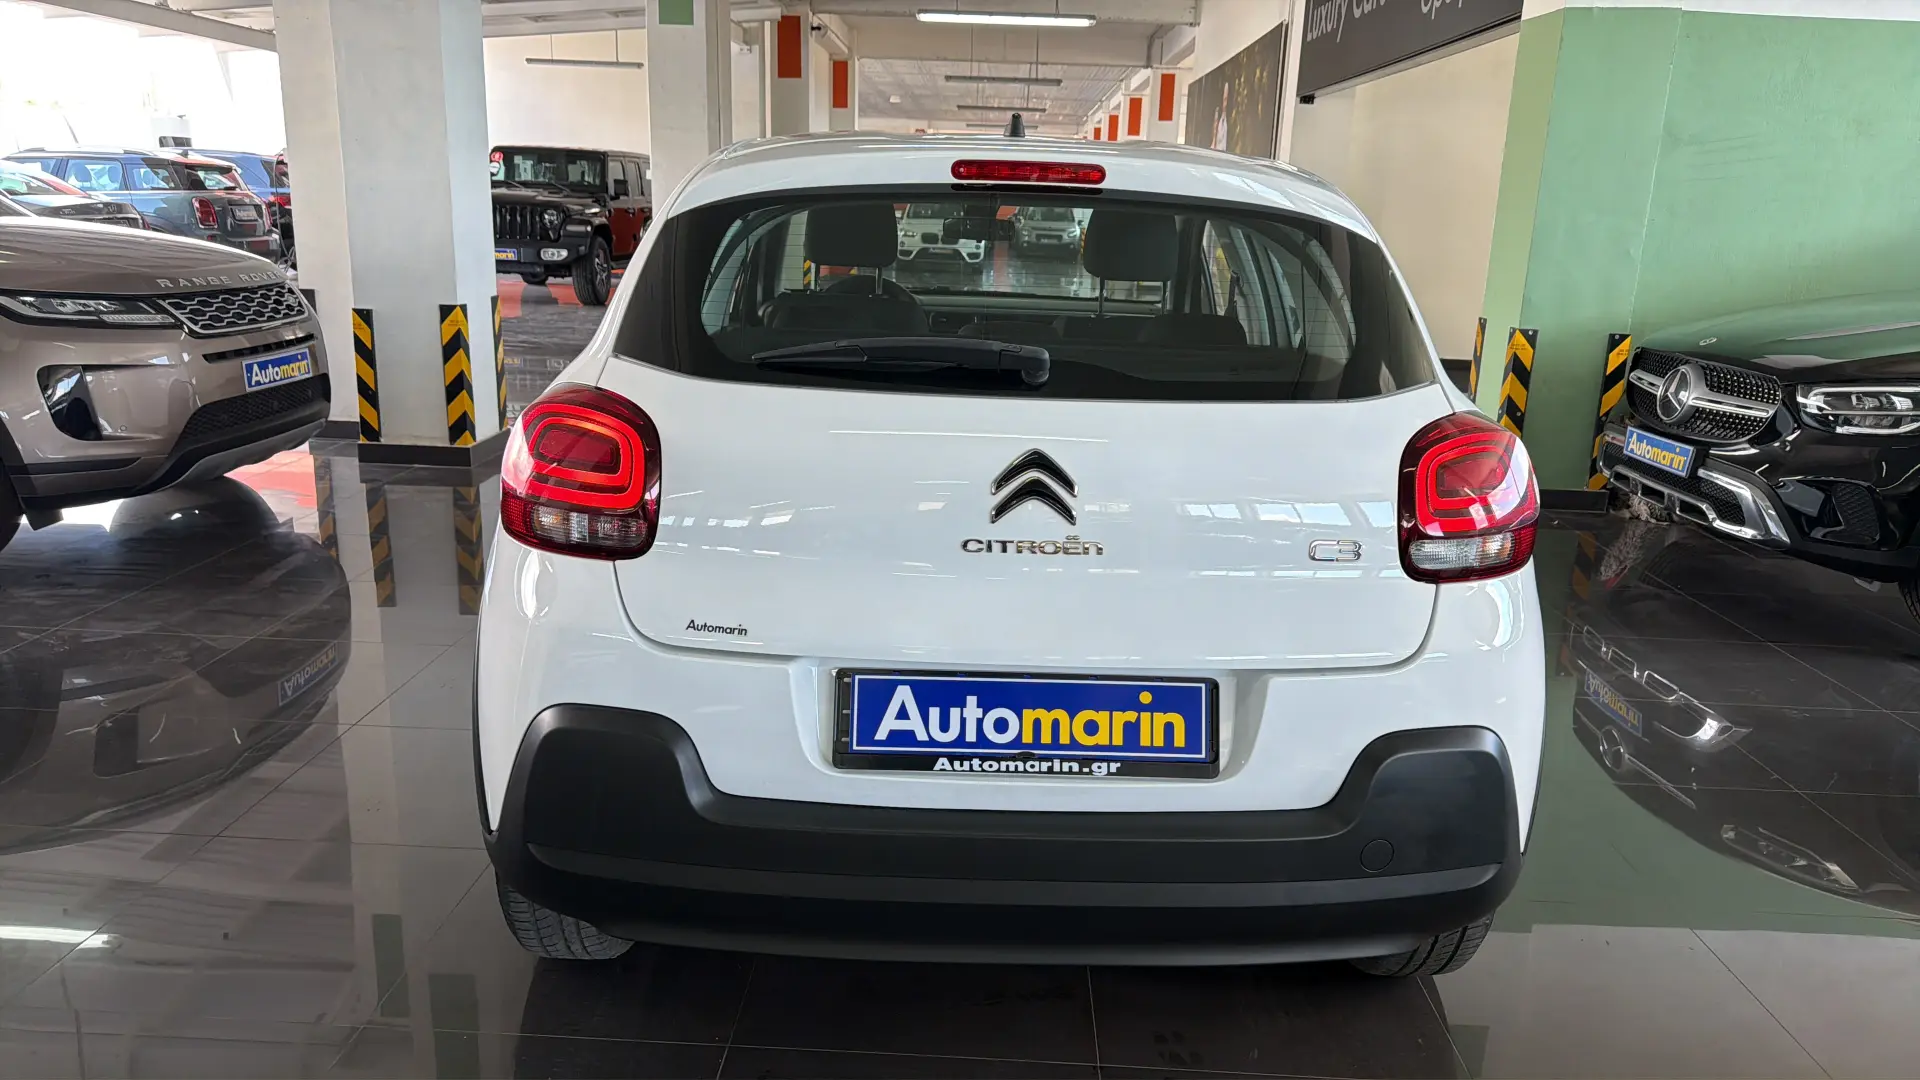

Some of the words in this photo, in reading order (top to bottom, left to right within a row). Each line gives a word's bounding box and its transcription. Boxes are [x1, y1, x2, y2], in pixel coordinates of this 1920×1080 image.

[1306, 0, 1348, 43] Luxury
[156, 276, 232, 288] RANGE
[251, 354, 309, 386] Automarin
[1628, 432, 1685, 471] Automarin
[1308, 539, 1362, 562] C3
[685, 619, 748, 636] Automarin
[873, 684, 1186, 748] Automarin
[932, 757, 1122, 776] Automarin.gr
